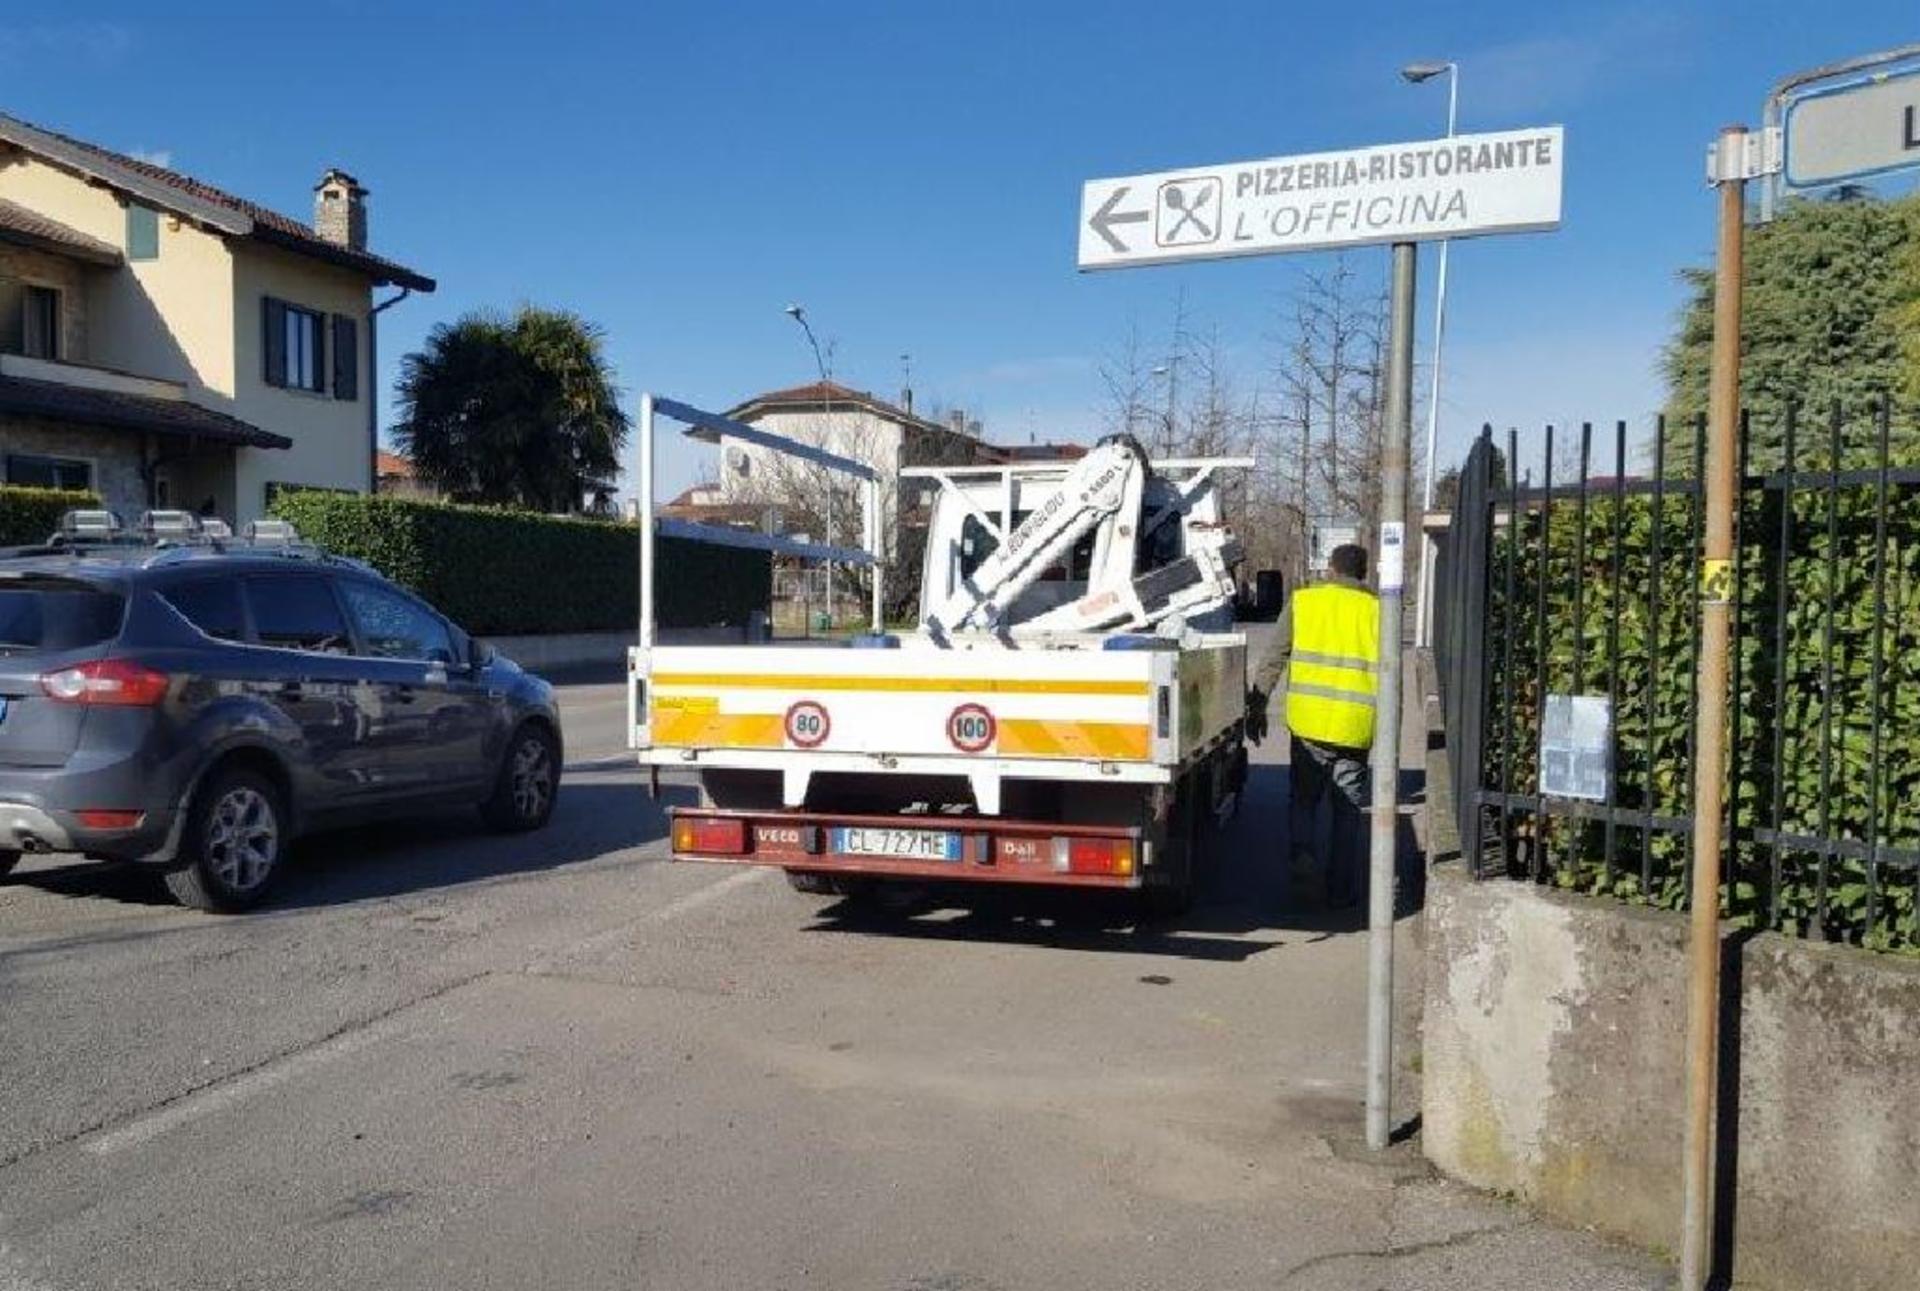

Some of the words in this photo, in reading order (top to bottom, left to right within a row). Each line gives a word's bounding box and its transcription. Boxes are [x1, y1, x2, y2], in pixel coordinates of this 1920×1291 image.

[1236, 138, 1552, 198] PIZZERIA-RISTORANTE
[1233, 188, 1467, 241] L'OFFICINA
[797, 714, 820, 735] 80
[956, 717, 987, 738] 100
